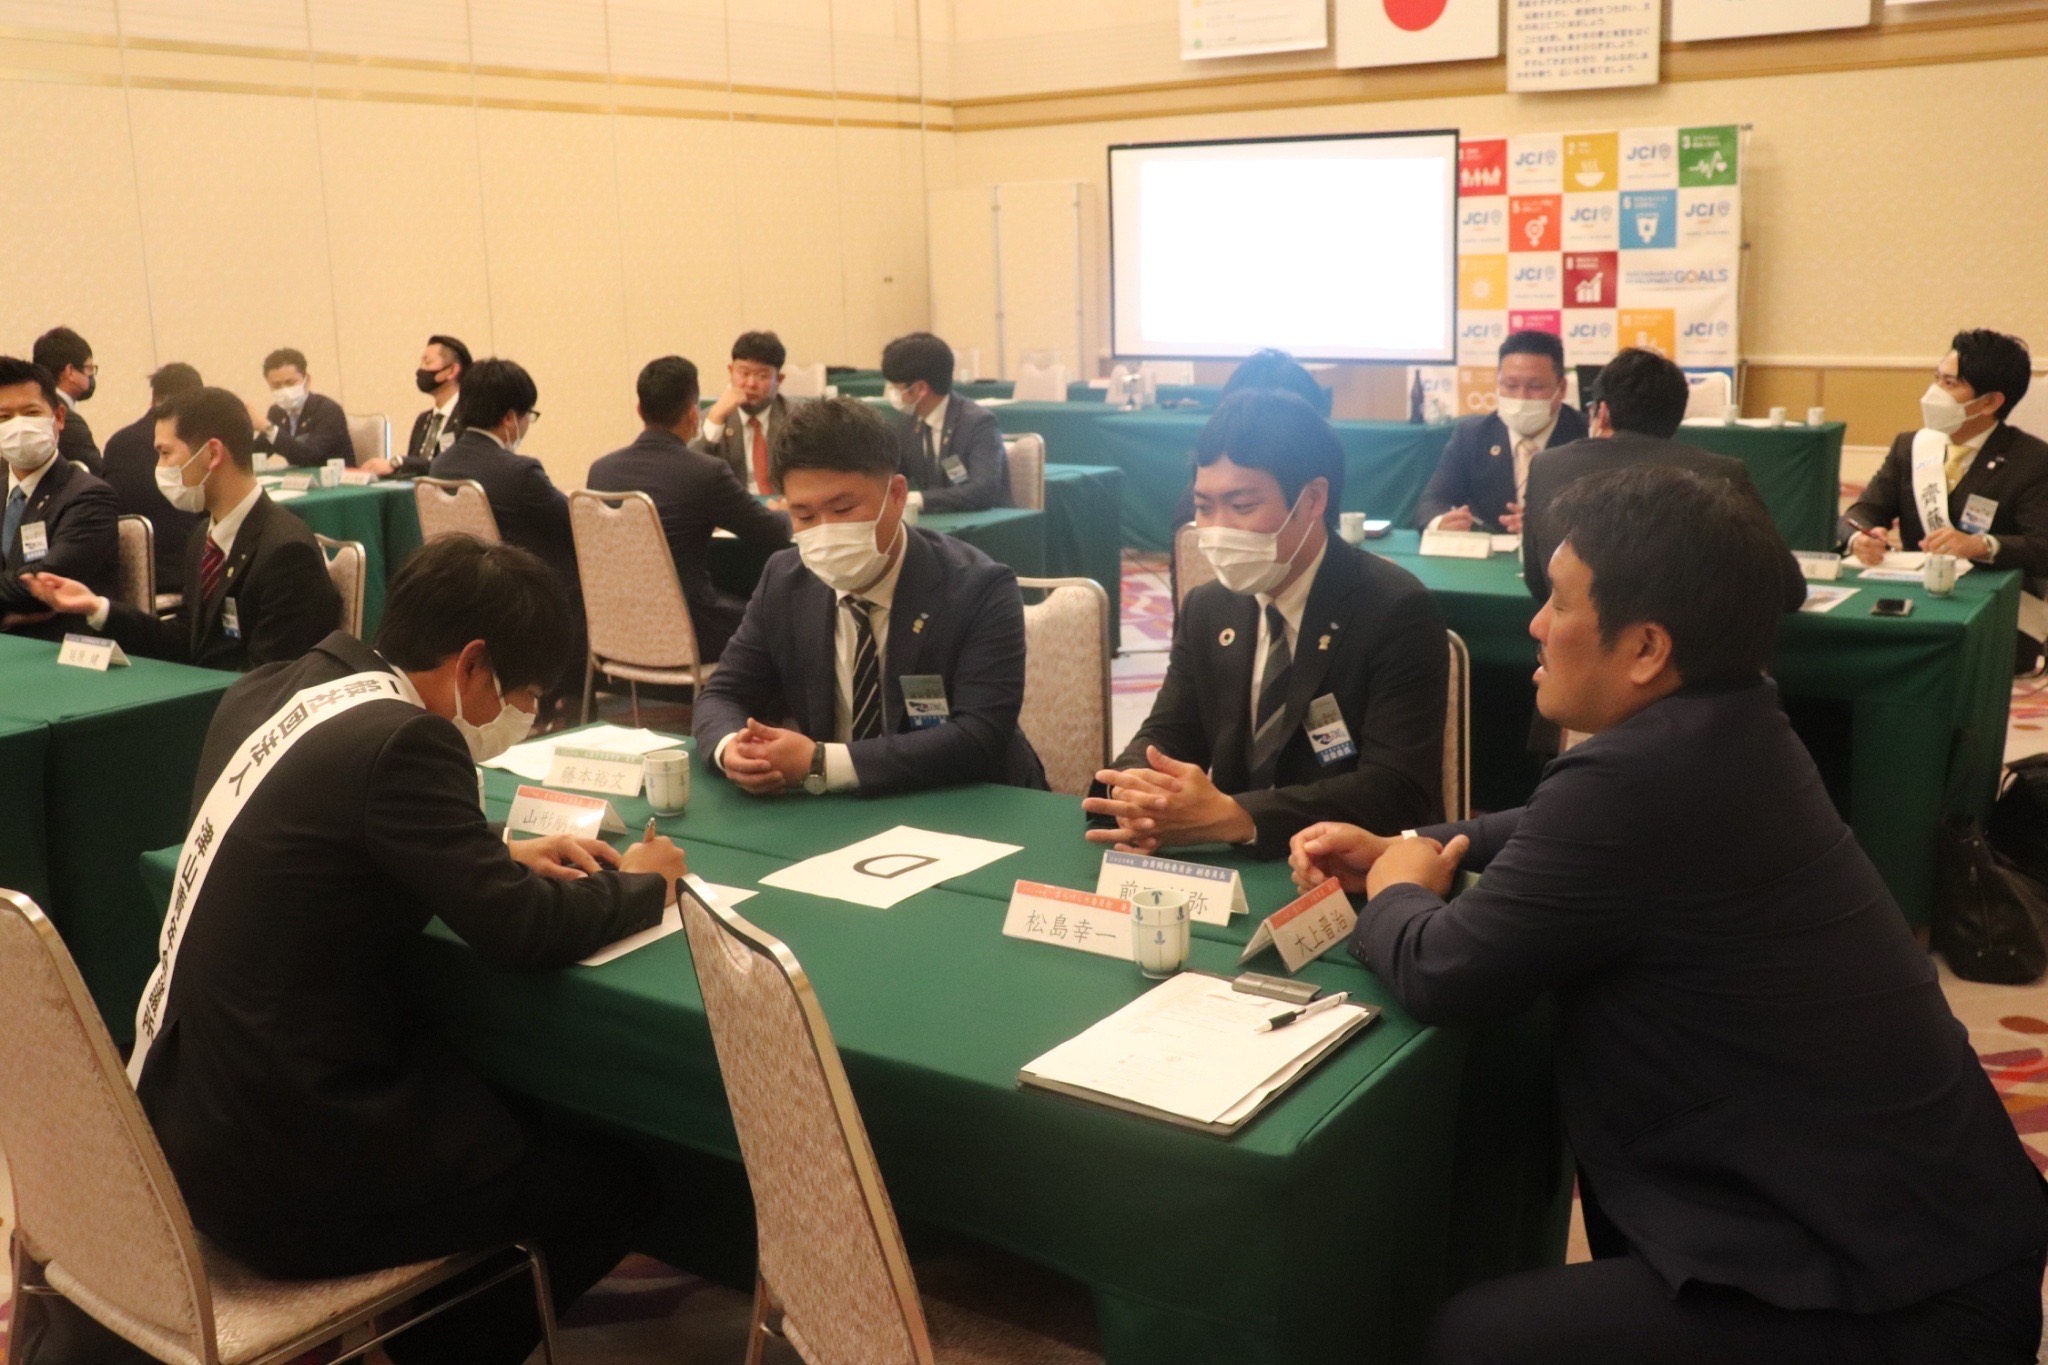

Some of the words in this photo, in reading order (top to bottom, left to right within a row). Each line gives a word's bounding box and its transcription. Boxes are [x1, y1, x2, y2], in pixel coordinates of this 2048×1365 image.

[1515, 152, 1544, 166] JCI
[1627, 145, 1657, 160] JCI
[1570, 208, 1598, 221] JCI
[1685, 203, 1715, 217] JCI
[1463, 212, 1488, 225] JCI
[1515, 267, 1542, 281] JCI
[1674, 268, 1728, 283] GOALS
[1462, 325, 1489, 337] JCI
[1569, 325, 1597, 337] JCI
[1684, 323, 1714, 336] JCI
[228, 677, 401, 798] 一般社団法人
[853, 852, 941, 879] D
[1026, 909, 1117, 943] 松島幸一
